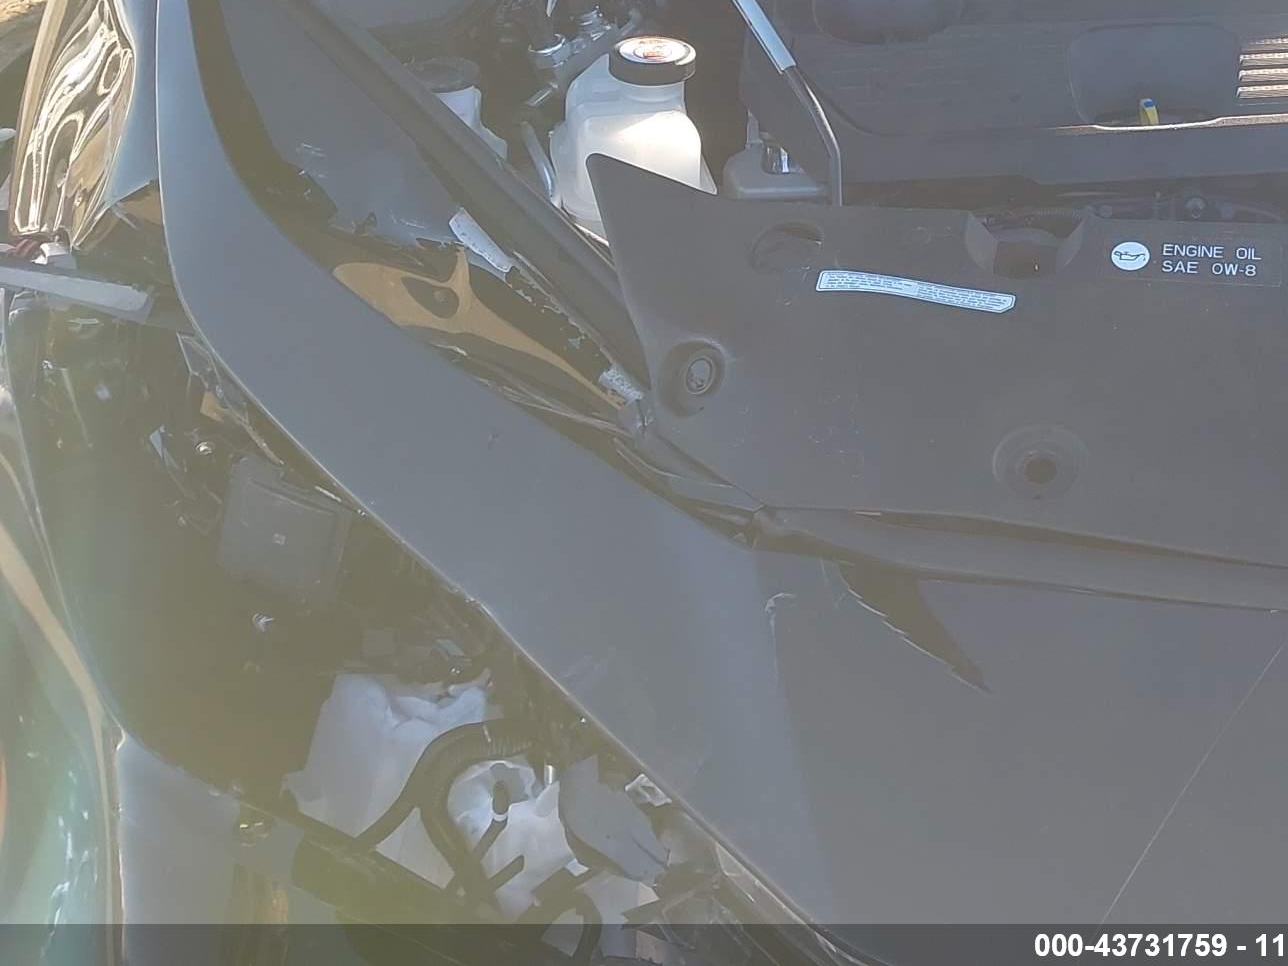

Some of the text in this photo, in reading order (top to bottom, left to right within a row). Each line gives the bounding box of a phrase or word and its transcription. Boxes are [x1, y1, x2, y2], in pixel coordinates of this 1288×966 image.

[1162, 244, 1262, 260] ENGINE OIL
[1162, 260, 1199, 274] SAE
